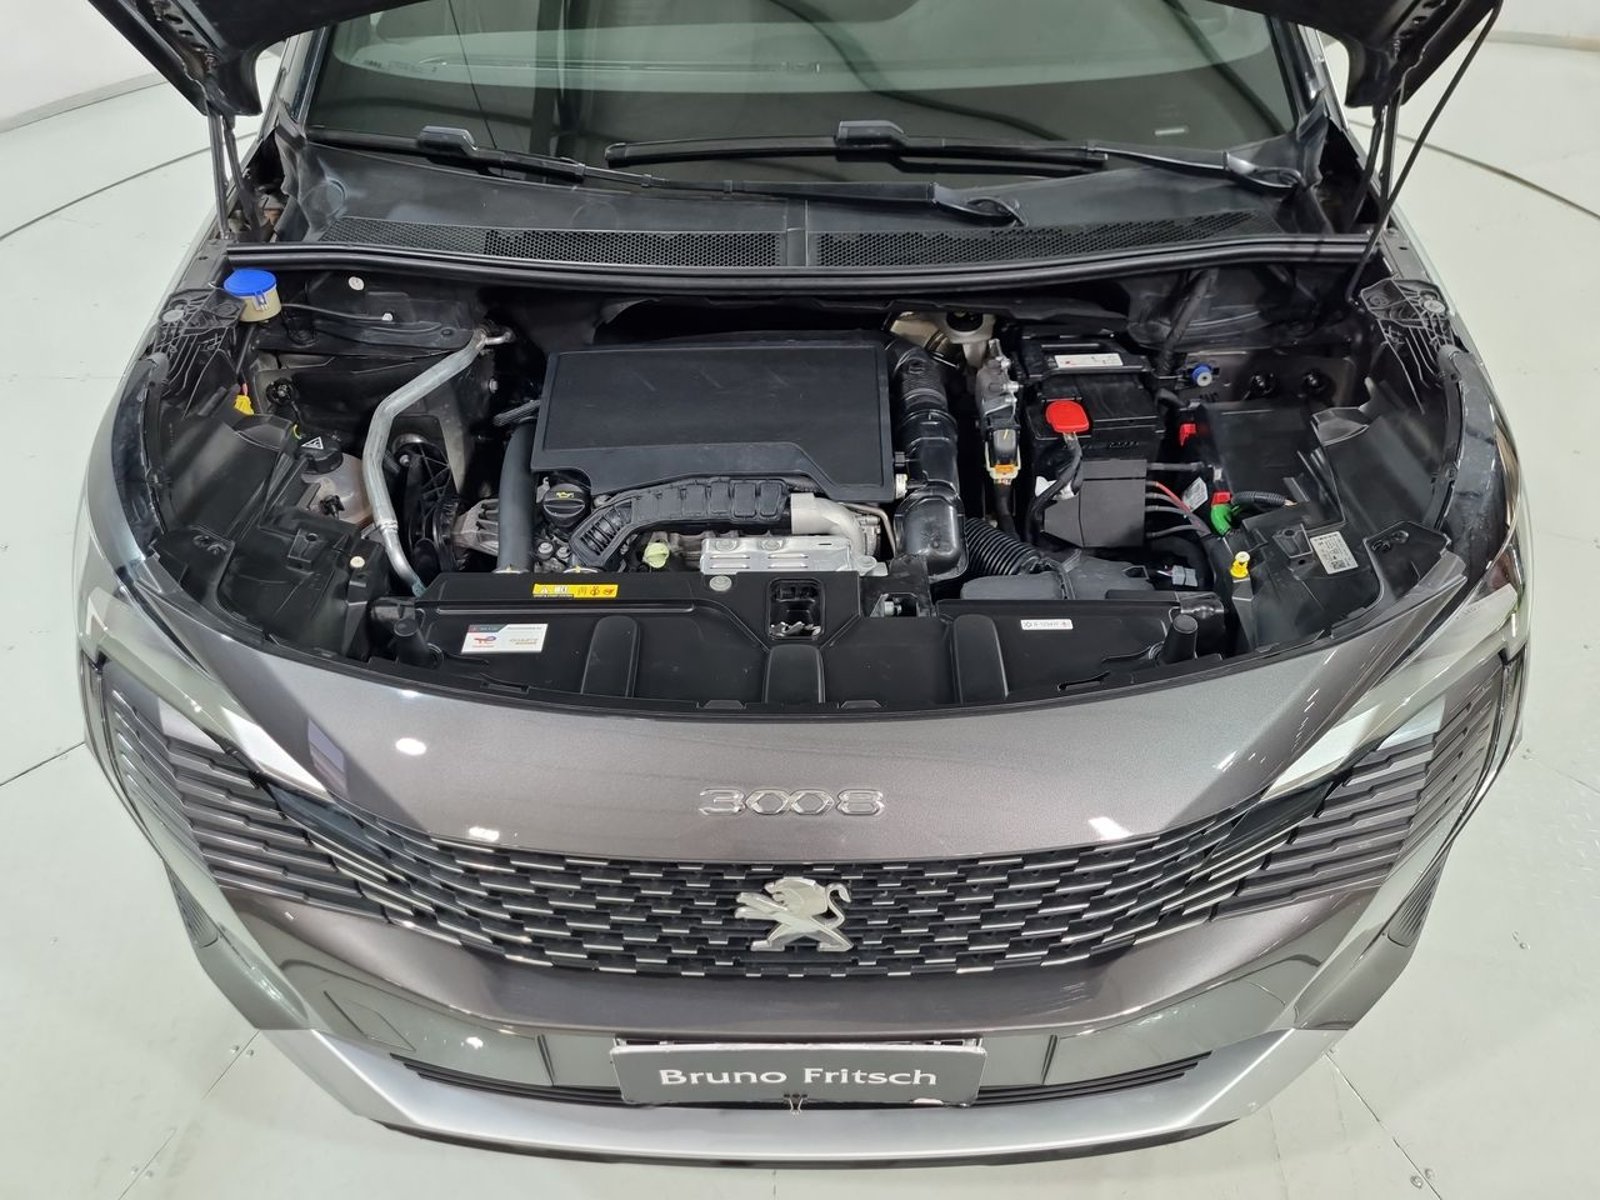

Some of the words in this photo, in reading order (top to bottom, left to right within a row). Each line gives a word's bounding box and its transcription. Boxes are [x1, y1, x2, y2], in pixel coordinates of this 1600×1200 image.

[699, 789, 885, 815] 3008
[658, 1068, 788, 1085] Bruno
[803, 1067, 938, 1086] Fritsch
